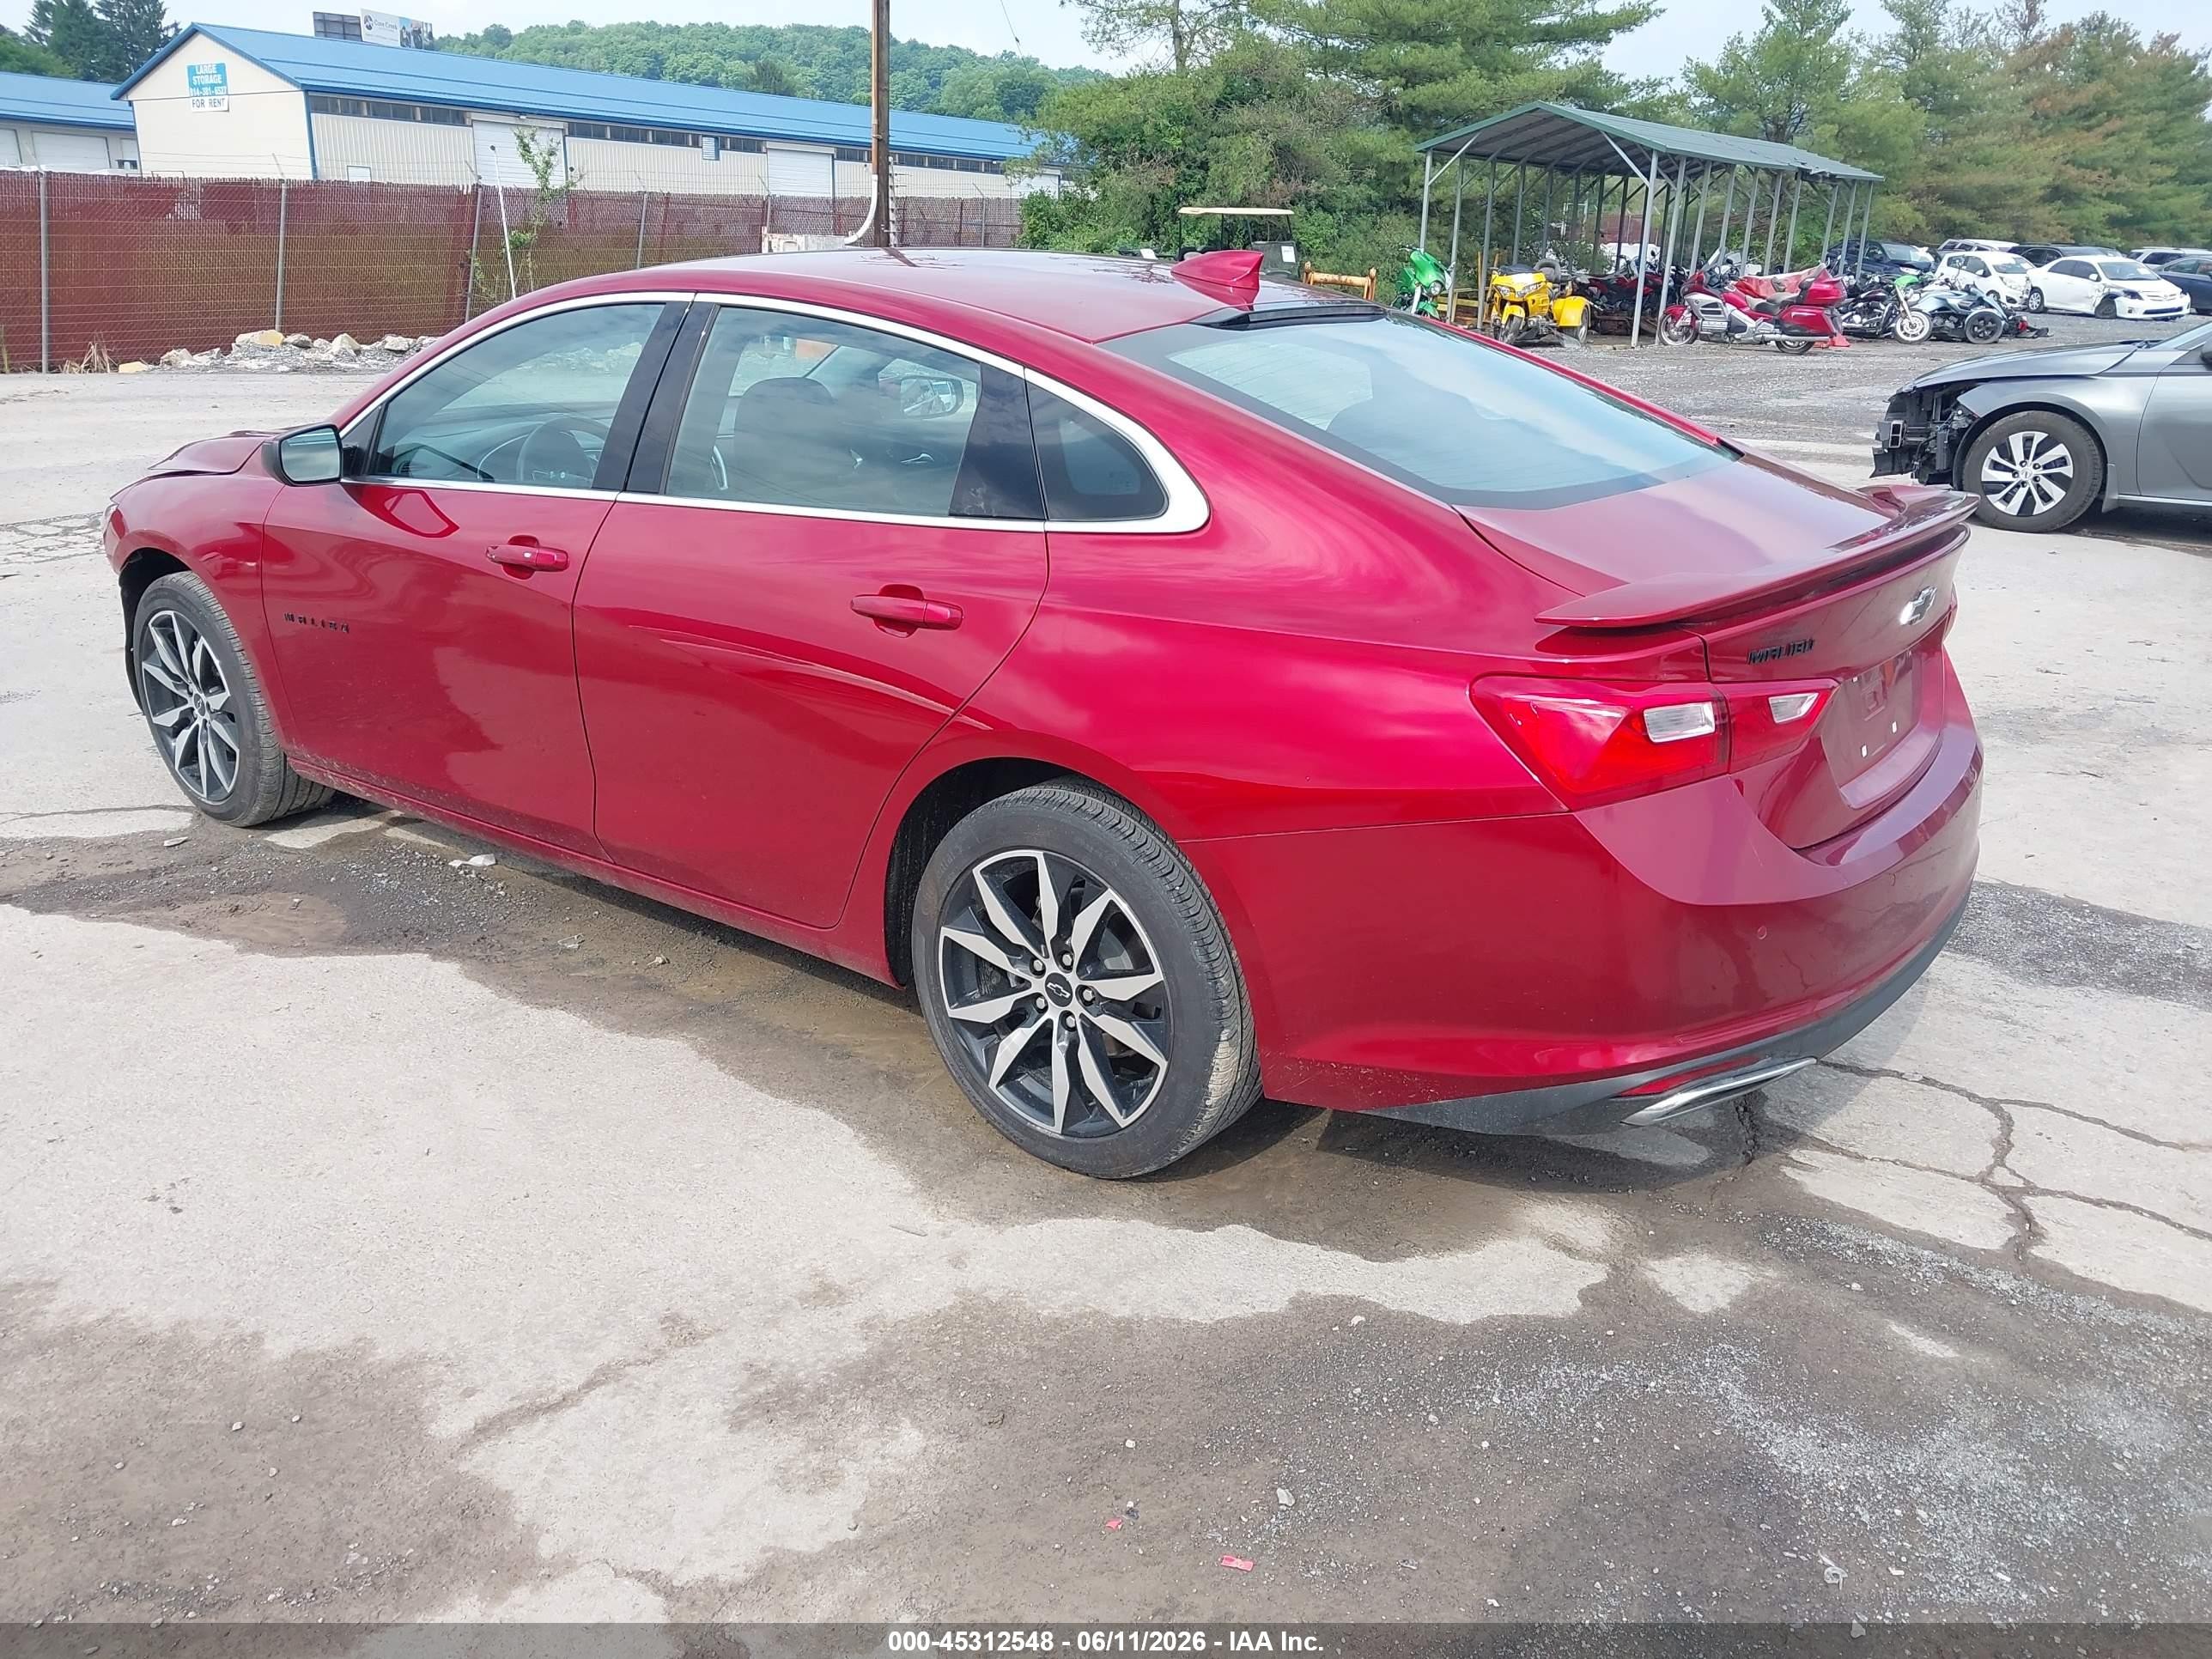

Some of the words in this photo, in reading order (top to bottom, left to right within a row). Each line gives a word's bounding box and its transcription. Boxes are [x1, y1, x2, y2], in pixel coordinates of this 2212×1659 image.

[195, 64, 217, 75] LARGE
[191, 74, 222, 85] STORAGE
[191, 99, 205, 108] FOR
[209, 98, 225, 108] RENT
